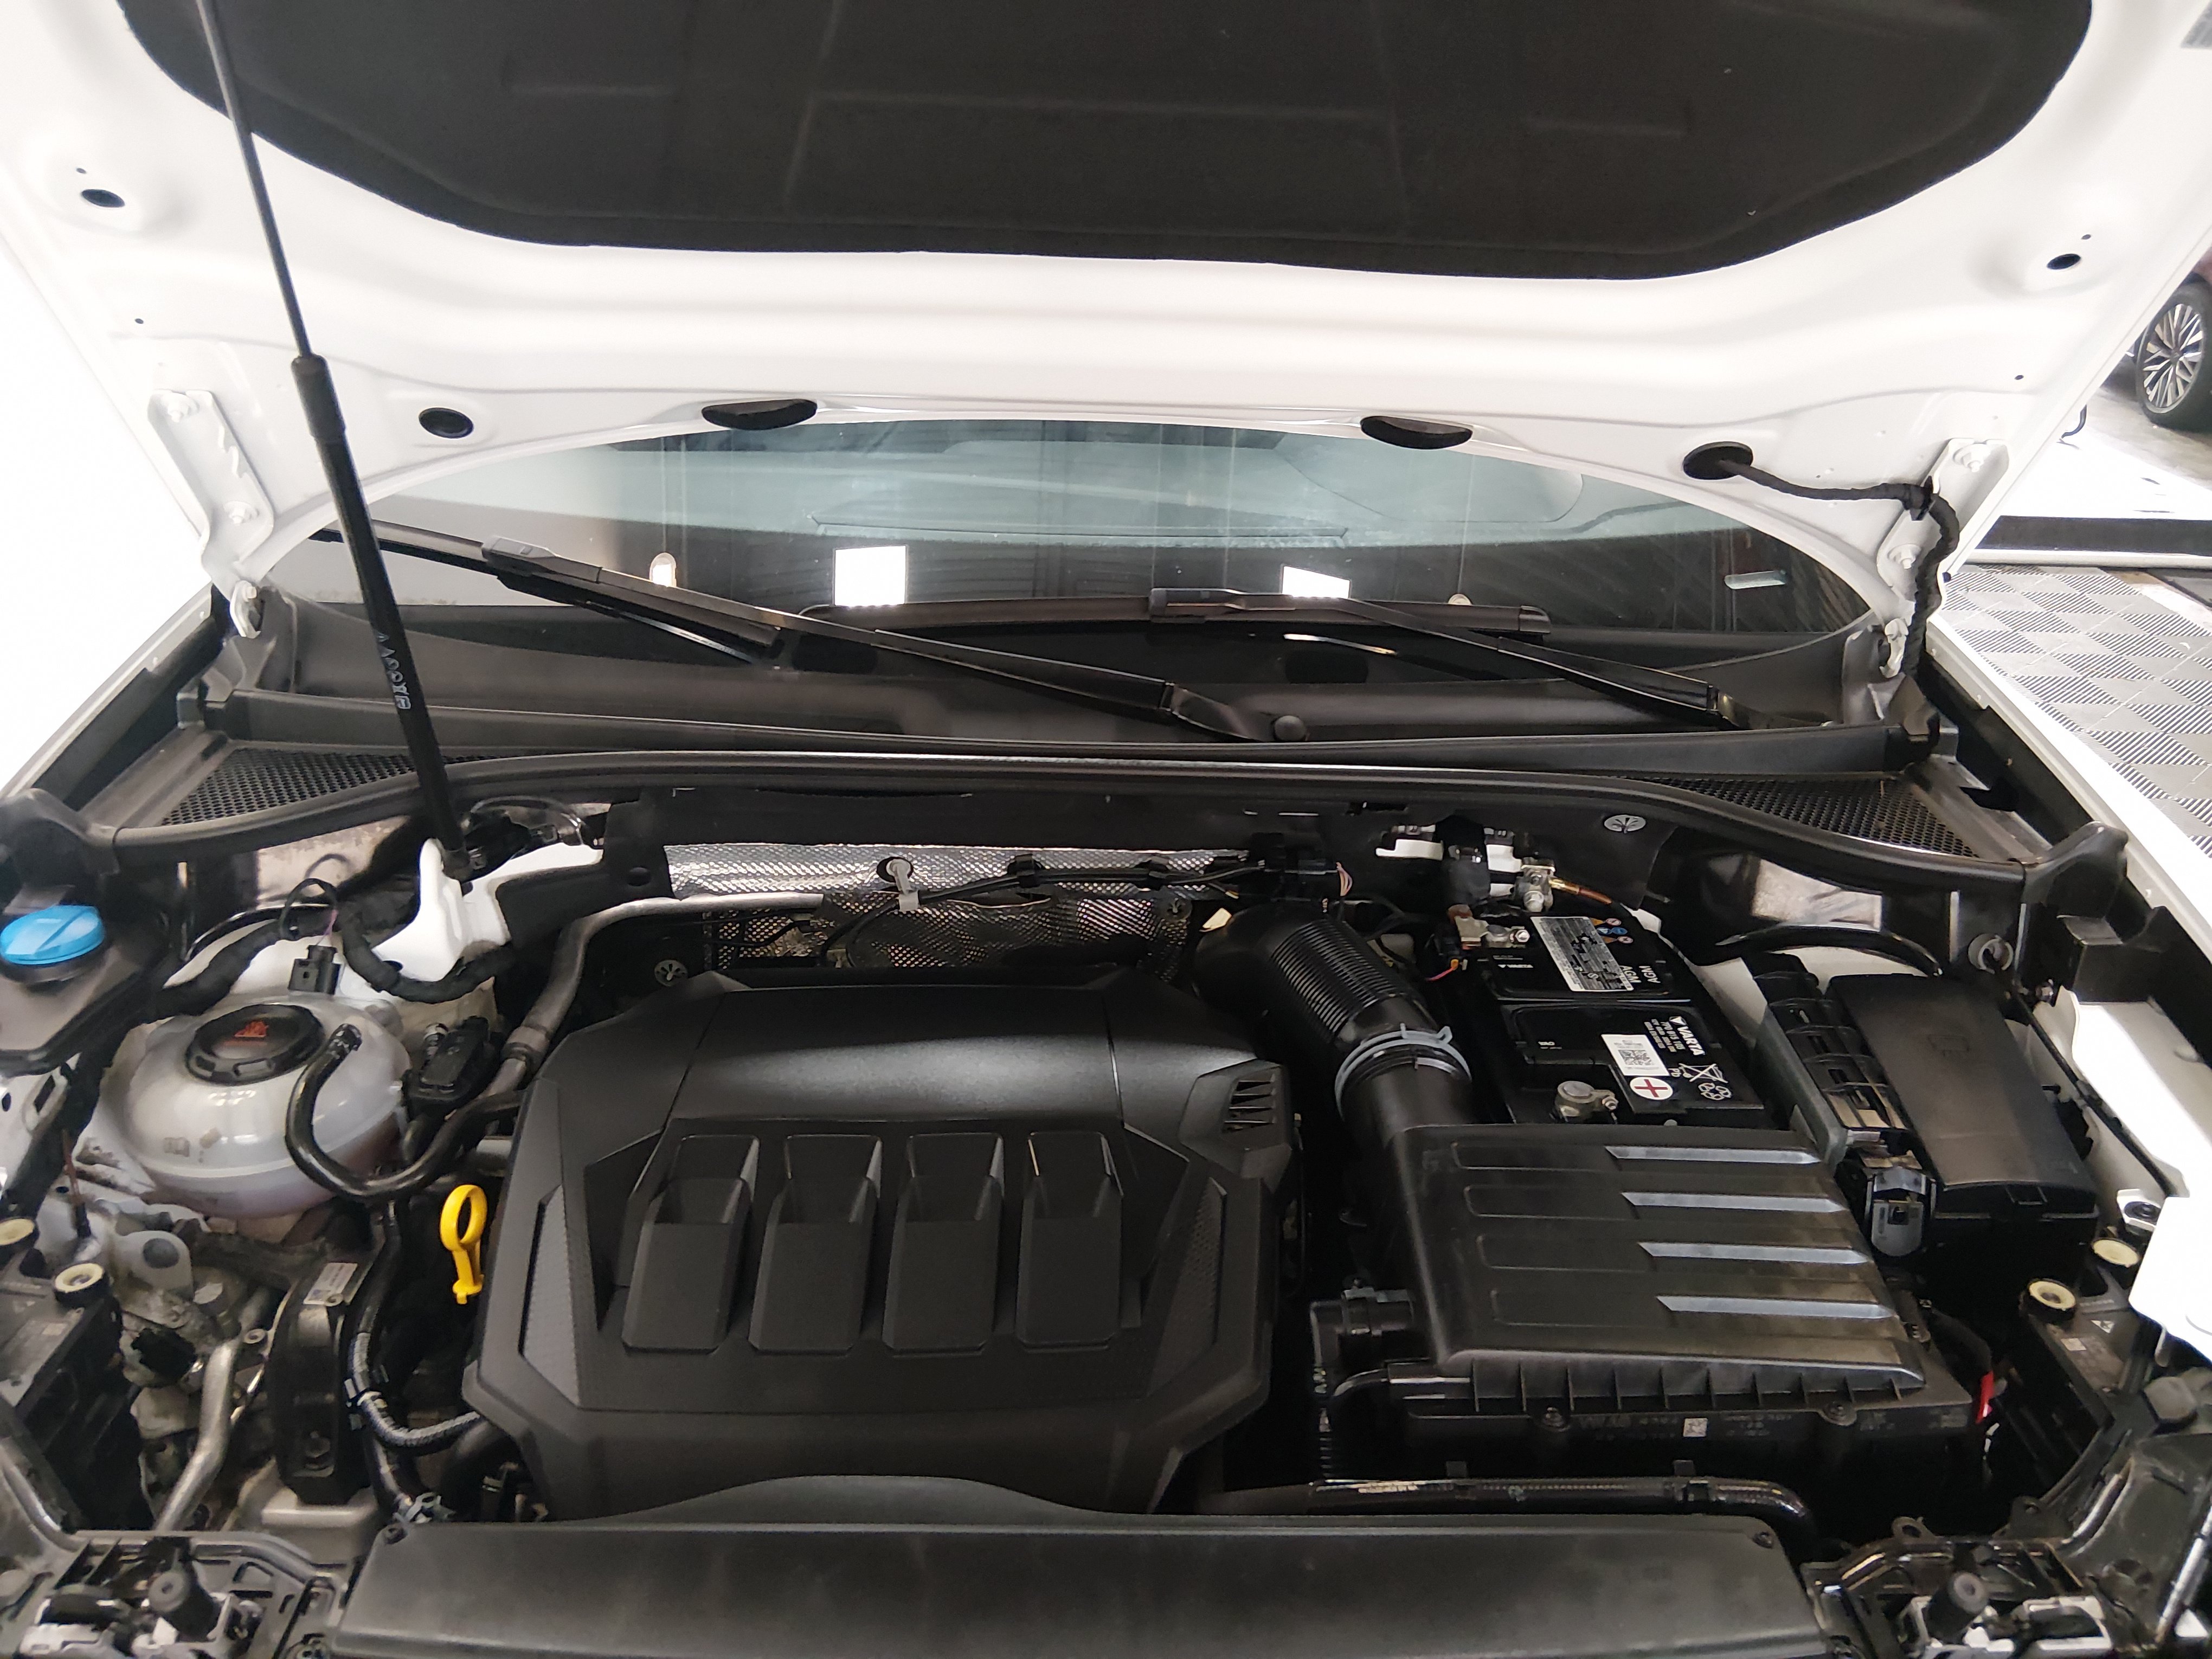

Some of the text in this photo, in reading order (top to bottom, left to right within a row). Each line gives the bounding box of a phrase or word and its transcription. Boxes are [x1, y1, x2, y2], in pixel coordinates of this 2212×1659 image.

[1619, 965, 1642, 983] AGM
[1638, 966, 1661, 983] AGM
[1677, 1026, 1706, 1056] VARTA
